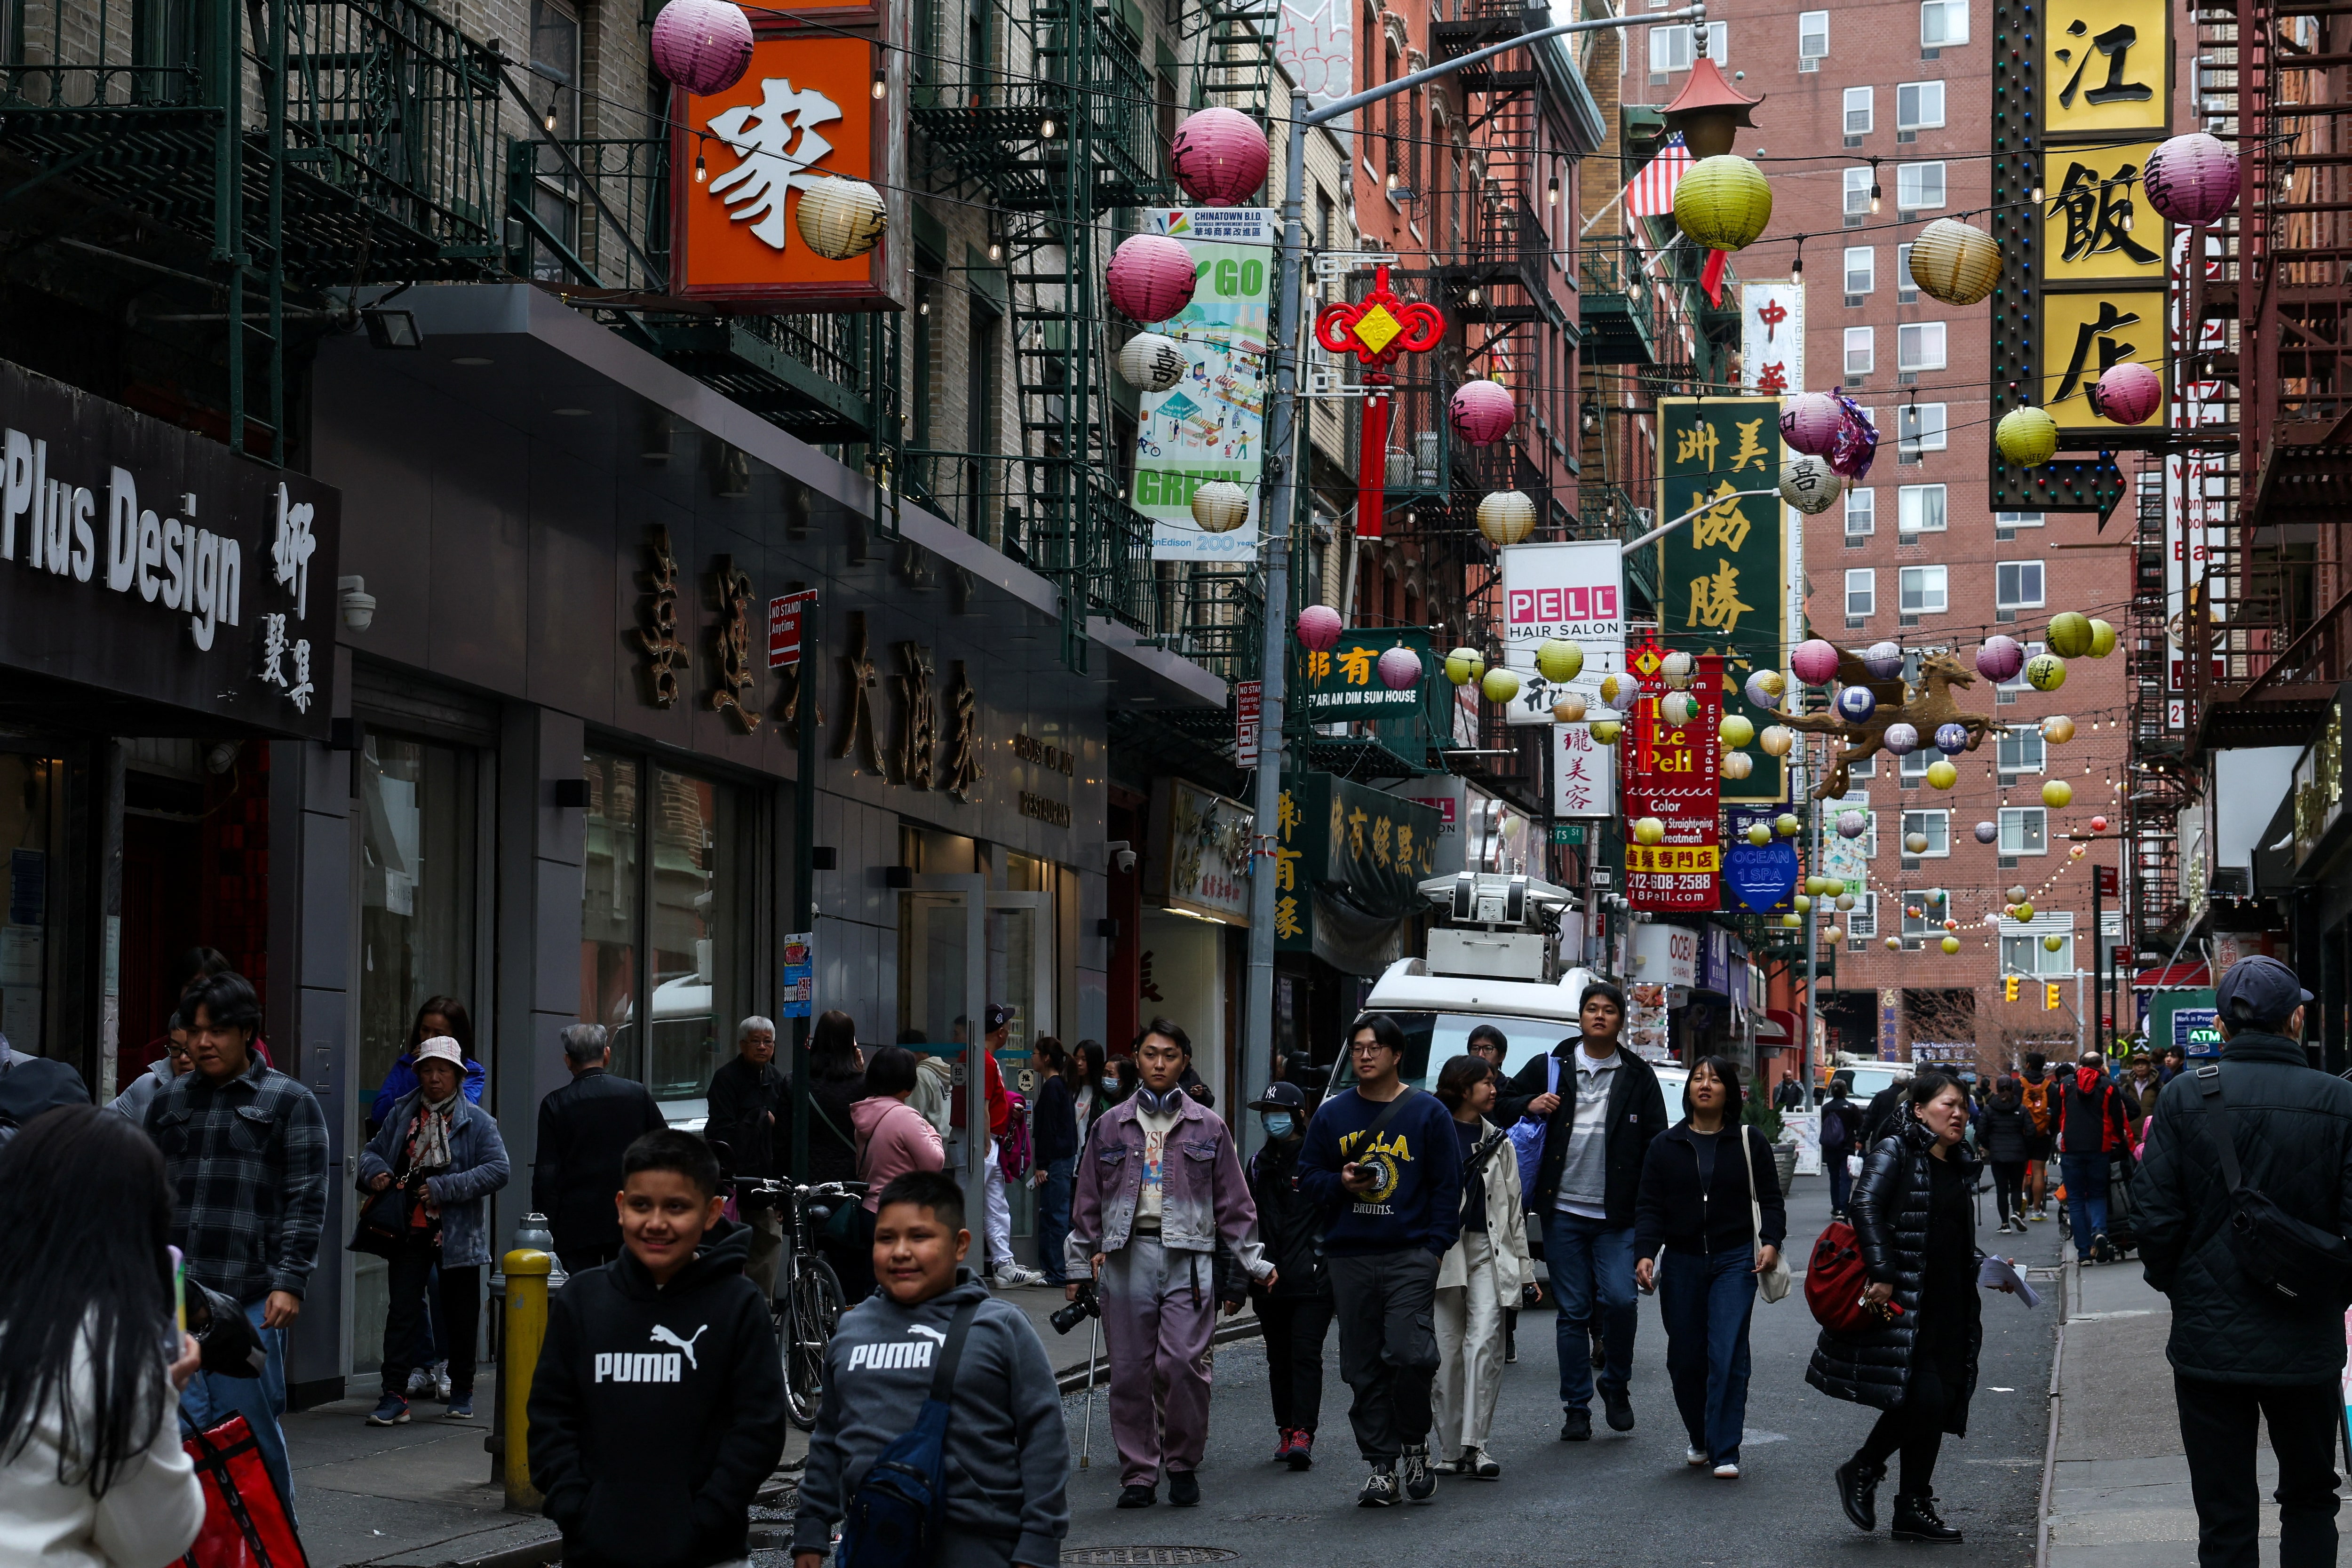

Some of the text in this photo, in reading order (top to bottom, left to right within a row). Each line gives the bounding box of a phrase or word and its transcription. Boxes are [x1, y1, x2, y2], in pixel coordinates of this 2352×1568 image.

[706, 78, 844, 249] 家
[1195, 212, 1262, 221] CHINATOWN B.I.D.
[1195, 228, 1260, 236] 華埠商業改進區
[1215, 259, 1263, 296] GO
[1791, 459, 1821, 491] 喜
[1137, 469, 1241, 506] GRE
[0, 428, 240, 651] Plus Design
[1152, 538, 1191, 547] onEdison
[1197, 535, 1234, 551] 200
[772, 601, 801, 619] NO STANDI
[1512, 590, 1613, 619] PELL
[772, 620, 794, 636] Anytime
[1510, 623, 1618, 637] HAIR SALON
[1345, 692, 1361, 704] DIM
[1364, 691, 1383, 703] SUM
[1385, 690, 1416, 703] HOUSE
[1705, 704, 1715, 781] 18Pell.com
[1063, 752, 1075, 777] JOY
[1023, 792, 1072, 828] RESTAURANT
[1651, 799, 1681, 812] Color
[1669, 817, 1713, 832] Straightening
[1627, 850, 1712, 868] 直髮專門店
[1732, 850, 1789, 864] OCEAN
[1629, 873, 1710, 889] 212-608-2588
[1737, 868, 1782, 881] 1 SPA
[1631, 891, 1704, 901] 18Pell.com
[784, 986, 797, 1002] BOBBY
[2191, 1030, 2220, 1041] ATM
[955, 1067, 963, 1076] 拉
[1353, 1203, 1391, 1215] BRUINS
[847, 1341, 934, 1371] PUMA
[595, 1353, 681, 1383] PUMA
